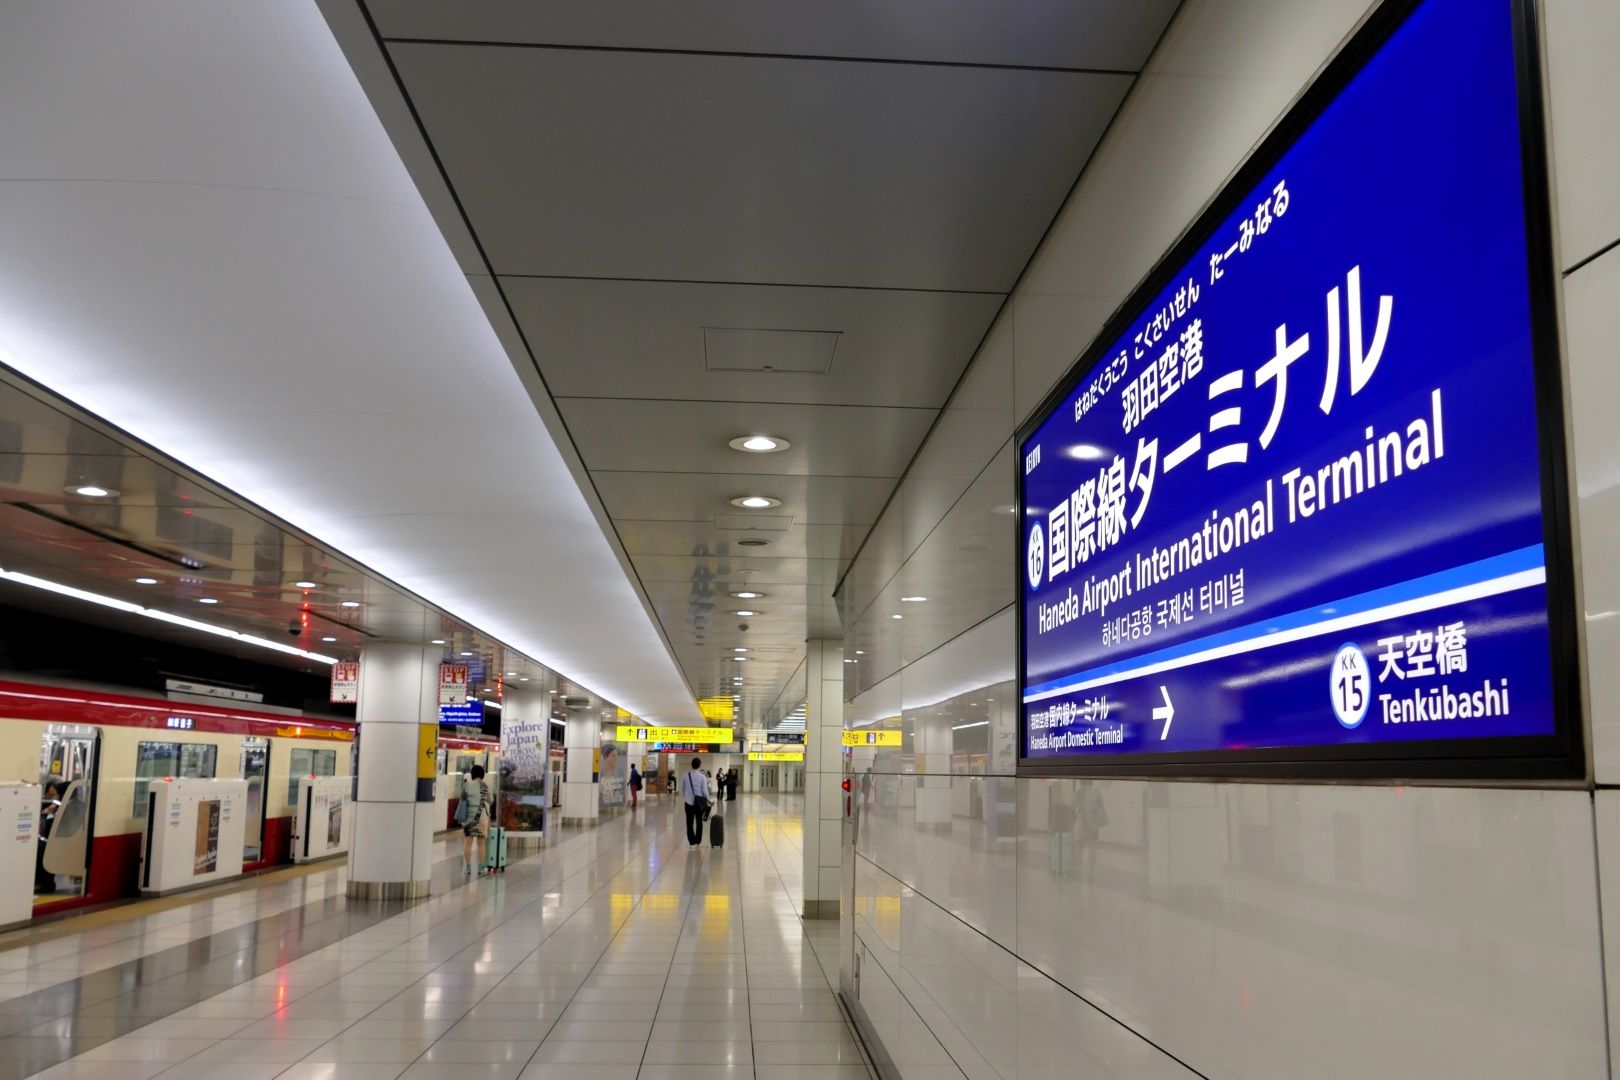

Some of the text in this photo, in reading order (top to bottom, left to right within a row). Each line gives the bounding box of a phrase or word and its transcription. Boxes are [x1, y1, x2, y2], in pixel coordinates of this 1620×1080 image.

[1074, 179, 1290, 423] はねだくうこう こくさいせん たーみなる
[1121, 318, 1204, 434] 羽田空港
[1048, 265, 1394, 582] 国際線ターミナル
[1039, 388, 1444, 634] Haneda Airport International Terminal
[1031, 545, 1042, 578] 16
[1102, 568, 1245, 648] 하네다공항 국제선 터미널
[1341, 653, 1357, 670] KK
[1377, 621, 1468, 683] 天空橋
[1338, 674, 1363, 712] 15
[1379, 678, 1510, 724] Tenkūbashi
[503, 721, 543, 737] Explore
[507, 734, 539, 748] Japan
[1031, 723, 1123, 752] Haneda Airport Domestic Terminal
